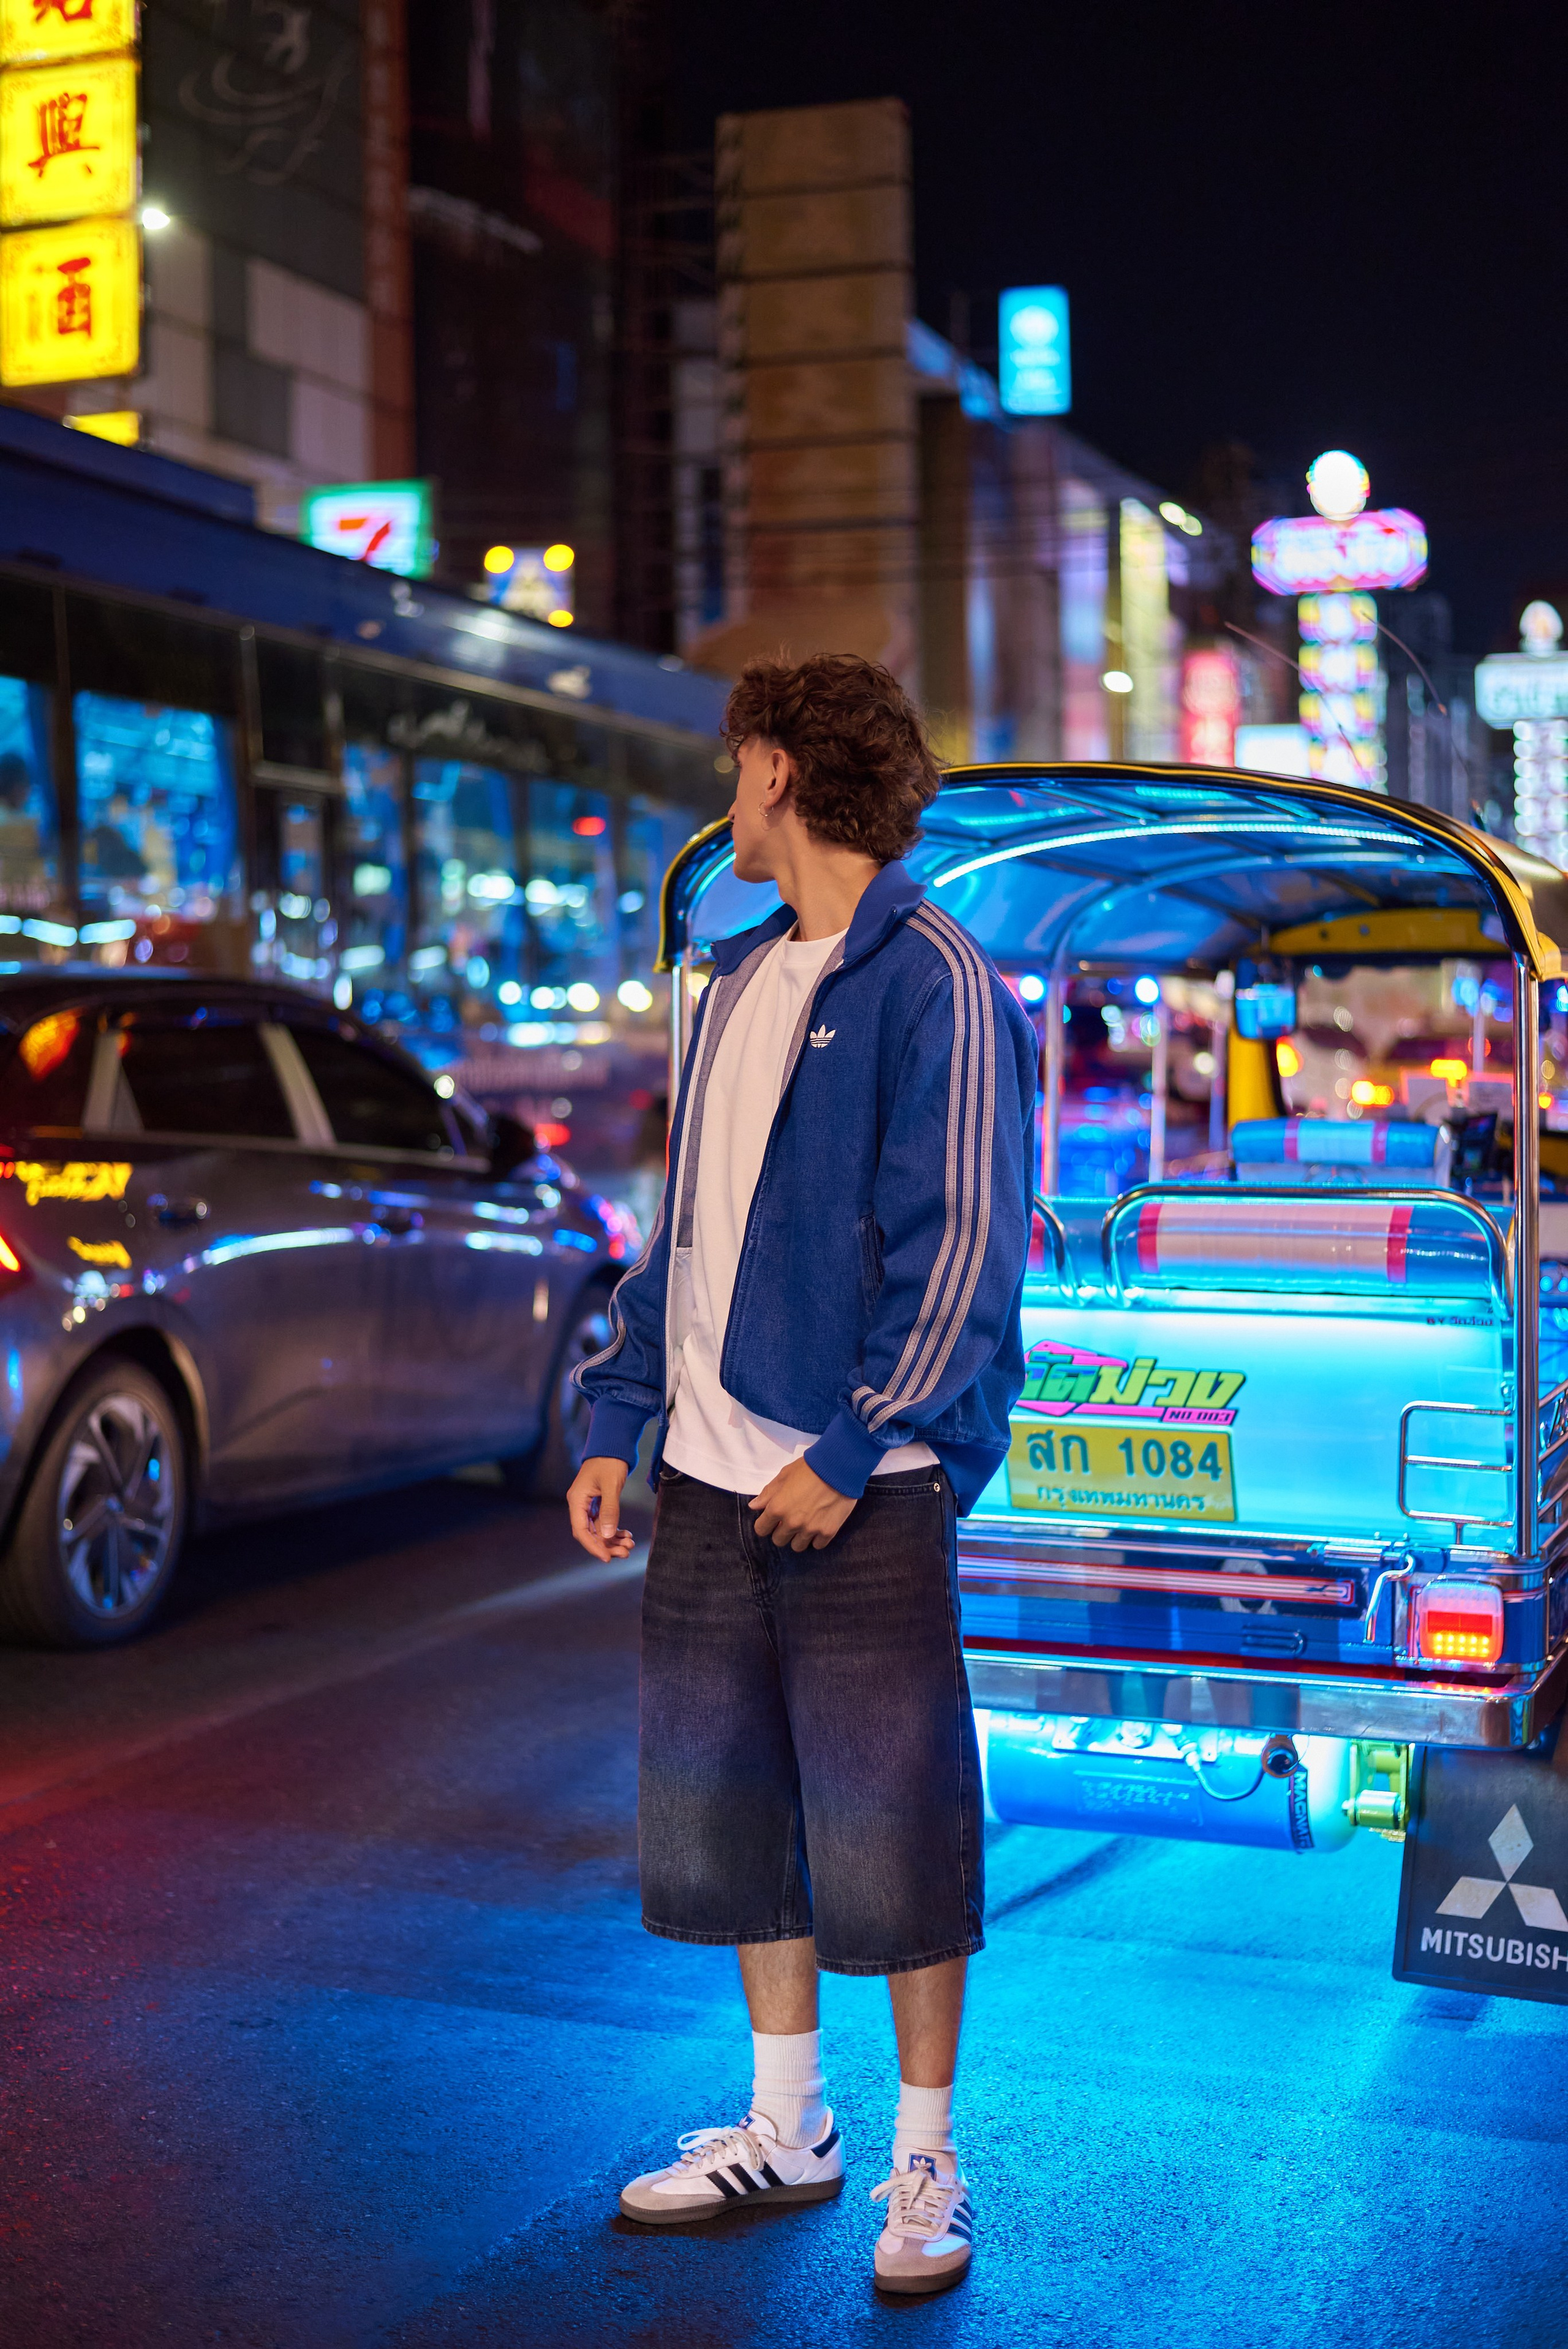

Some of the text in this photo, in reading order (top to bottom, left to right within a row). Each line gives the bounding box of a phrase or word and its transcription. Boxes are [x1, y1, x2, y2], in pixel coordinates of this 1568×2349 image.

[1027, 1430, 1223, 1482] สก 1084
[1037, 1485, 1205, 1510] กรุงเทพมหานคร
